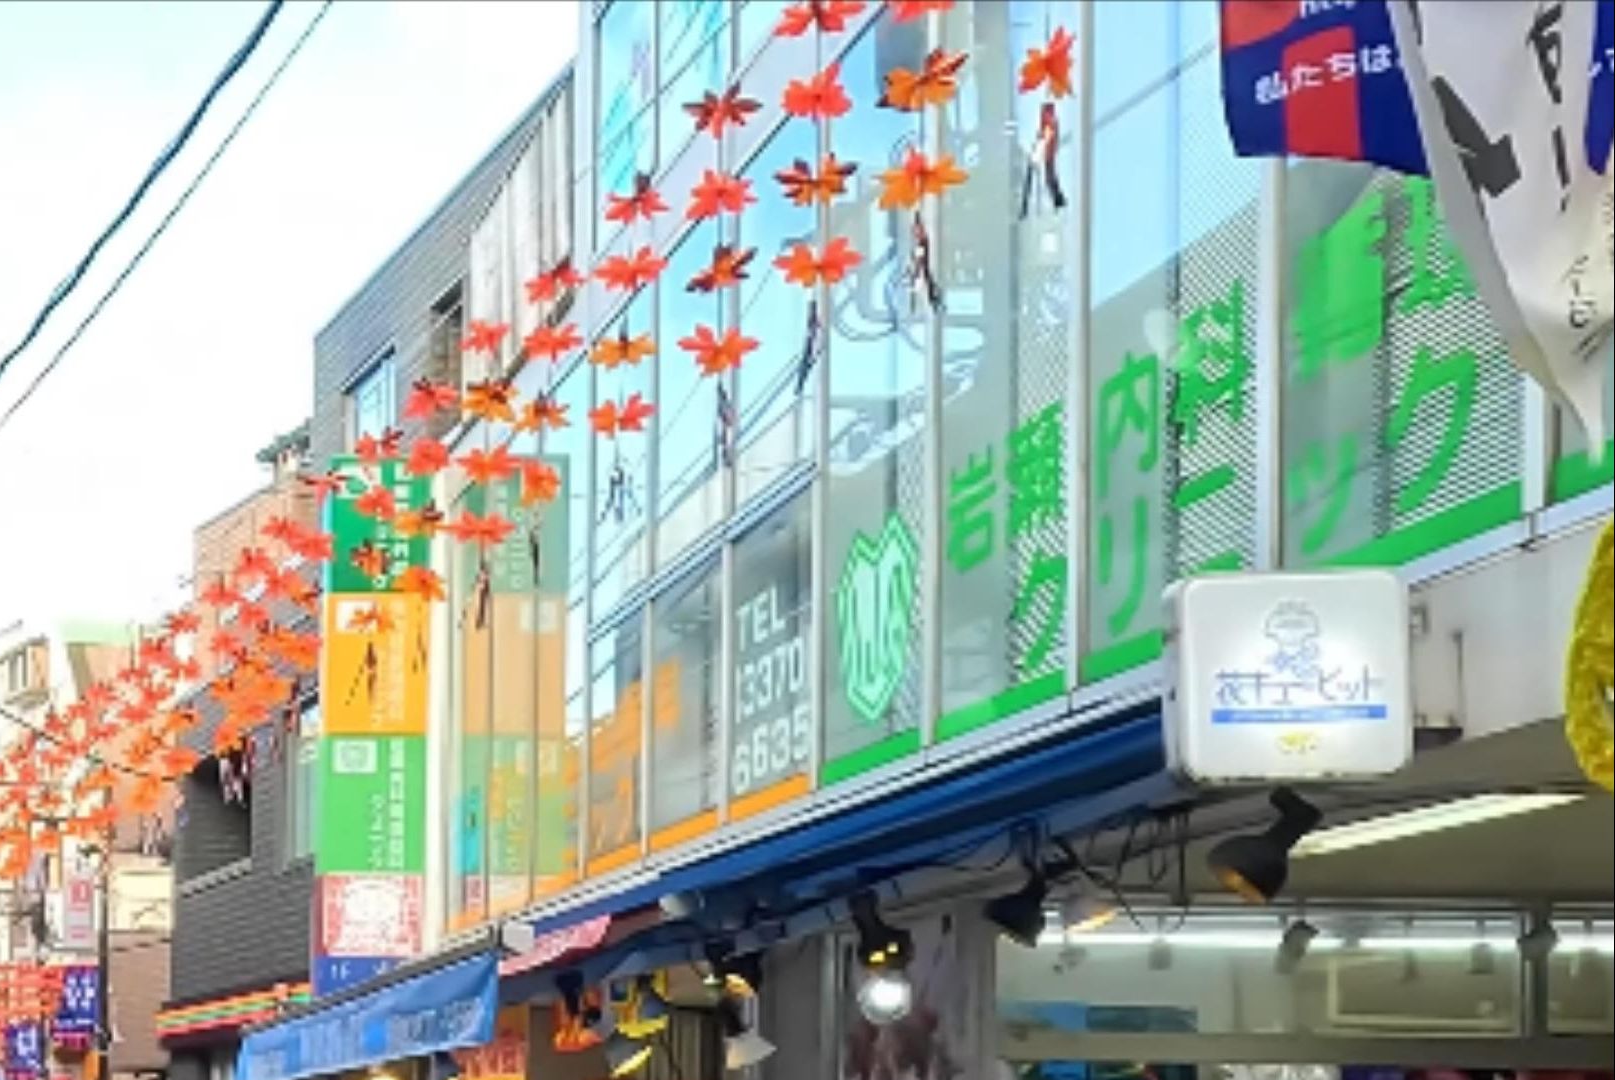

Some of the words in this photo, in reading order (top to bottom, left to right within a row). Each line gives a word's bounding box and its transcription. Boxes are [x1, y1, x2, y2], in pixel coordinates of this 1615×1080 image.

[1254, 45, 1400, 104] 私たちは
[737, 585, 784, 651] TEL
